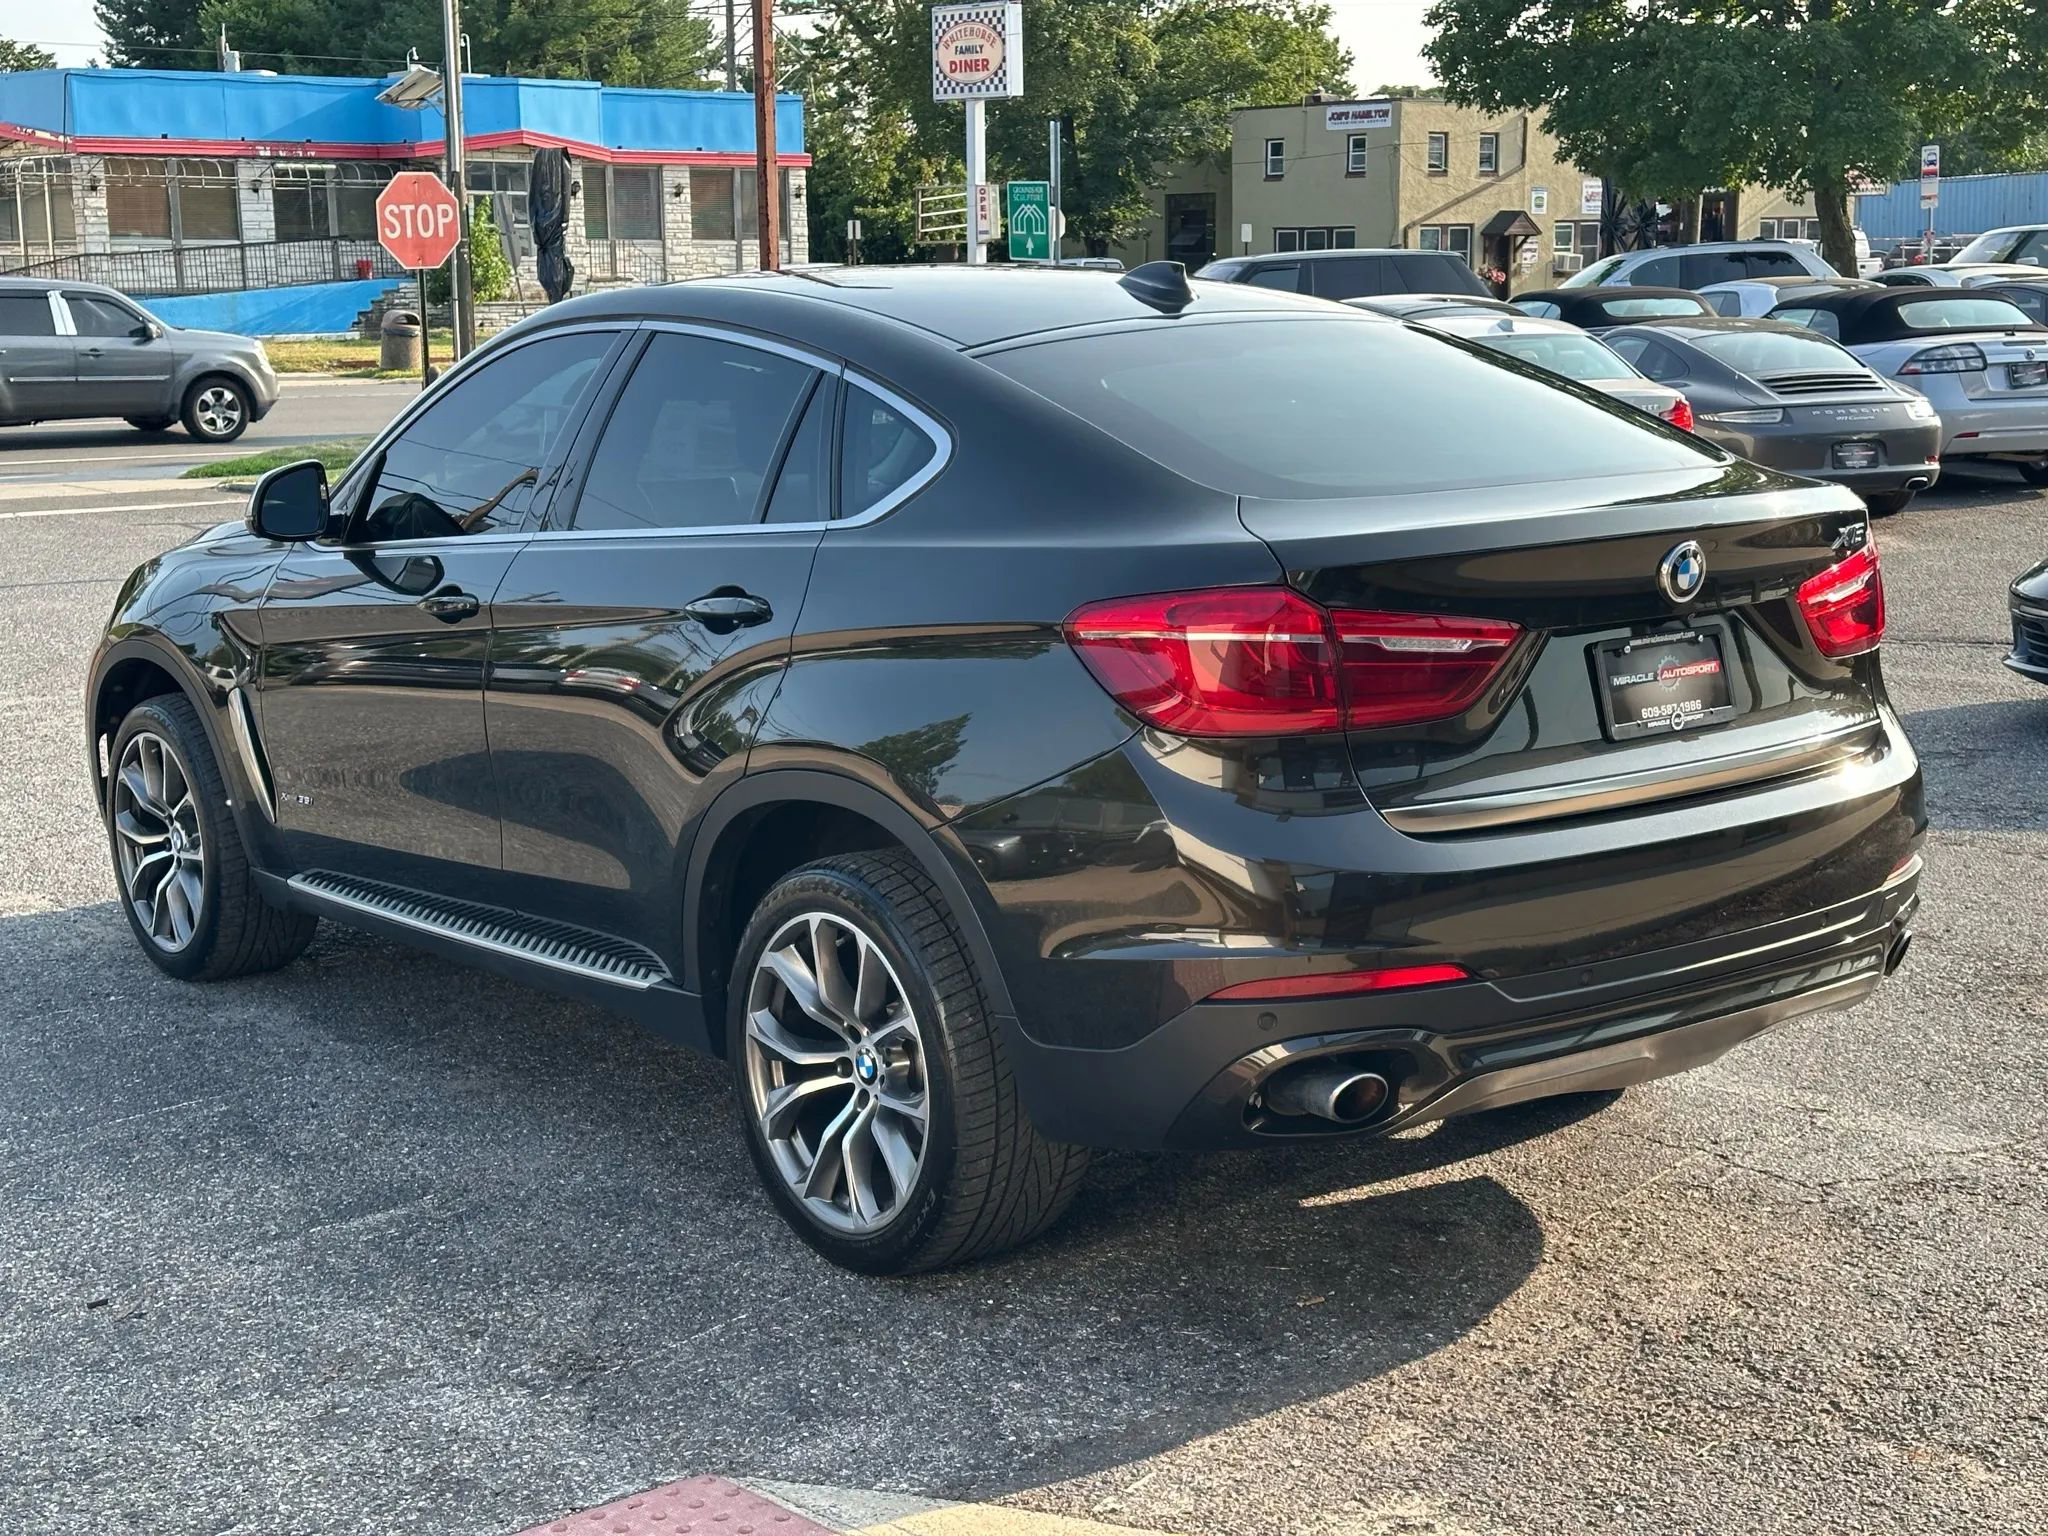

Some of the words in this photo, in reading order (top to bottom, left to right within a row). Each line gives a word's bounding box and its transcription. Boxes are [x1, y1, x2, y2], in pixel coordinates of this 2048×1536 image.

[942, 26, 998, 50] WHITEHORSE
[954, 44, 985, 56] FAMILY
[949, 58, 990, 74] DINER
[1351, 108, 1390, 119] HAMILTON
[979, 187, 988, 220] OPEN
[383, 203, 454, 239] STOP
[1812, 407, 1890, 415] PORSCHE
[1613, 672, 1654, 687] MIRACLE
[1661, 662, 1717, 680] AUTOSPORT
[1641, 699, 1702, 719] 609-587-1986
